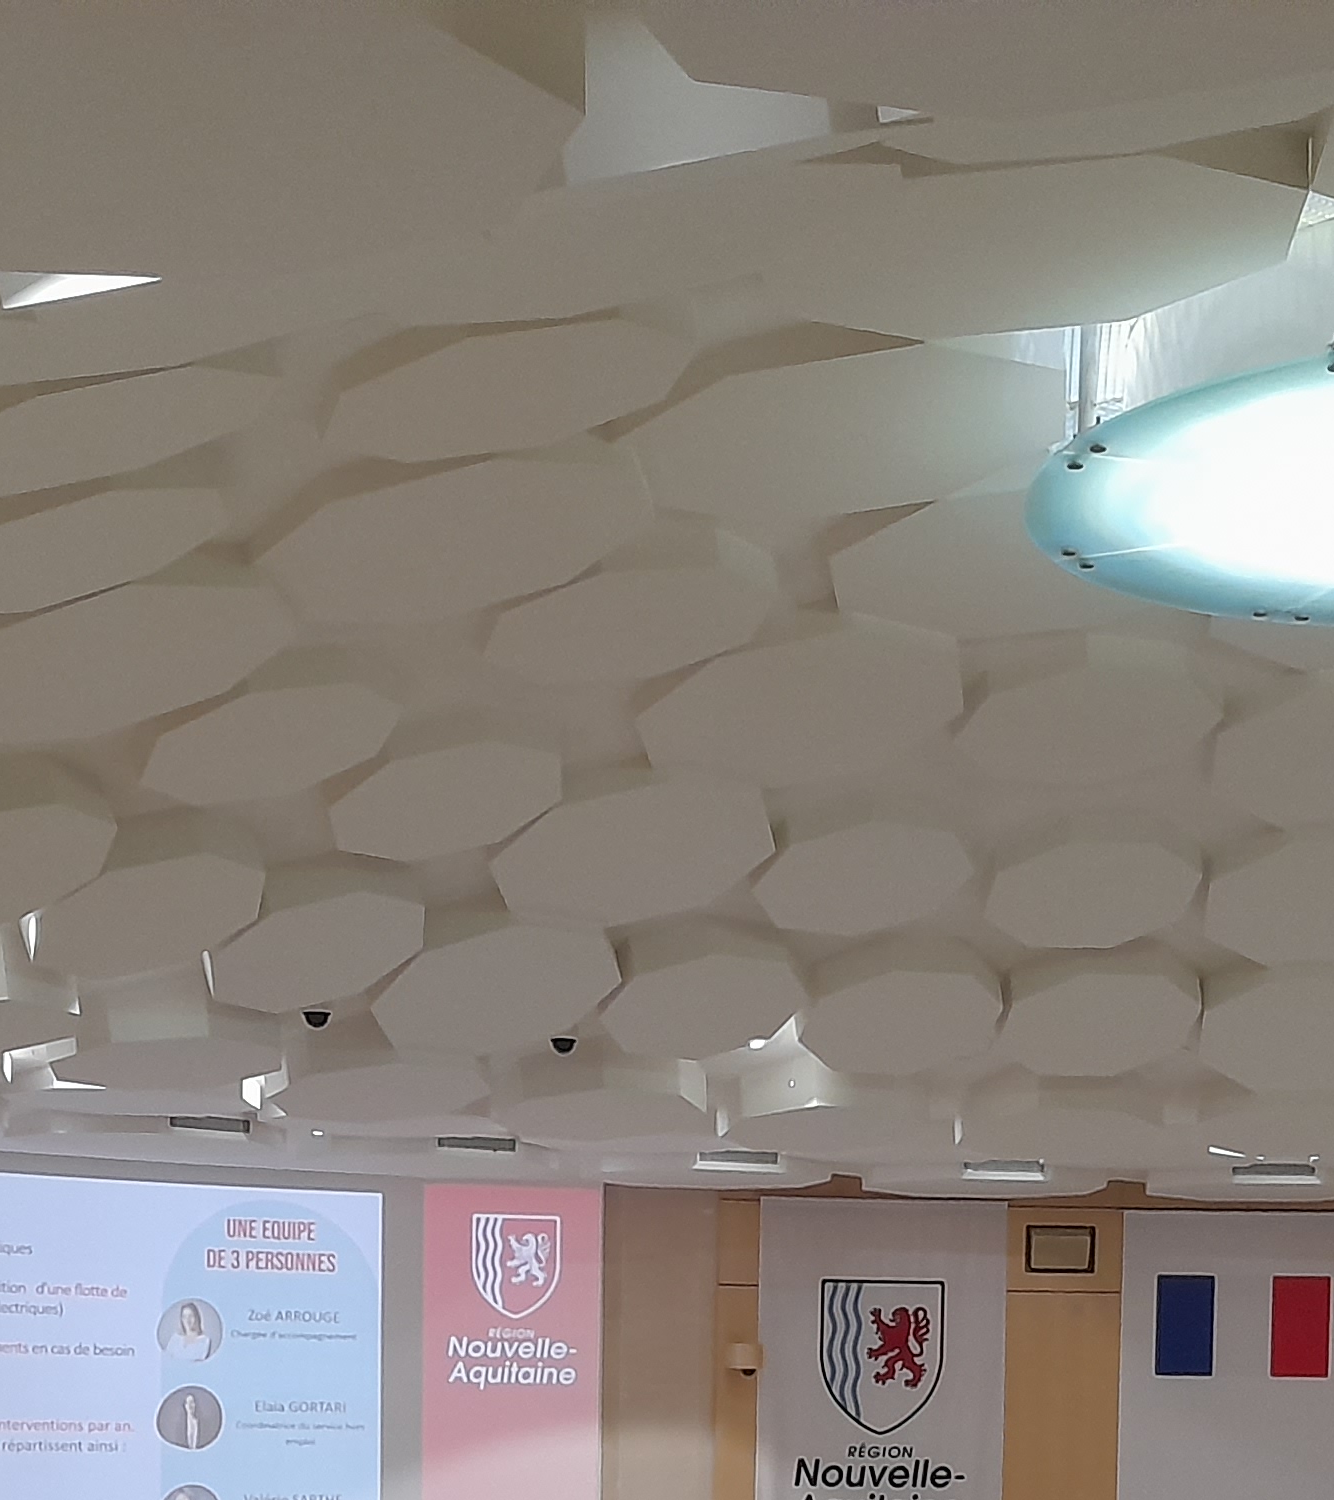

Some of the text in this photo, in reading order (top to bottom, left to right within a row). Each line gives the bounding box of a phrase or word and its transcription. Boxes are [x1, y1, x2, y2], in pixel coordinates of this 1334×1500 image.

[226, 1218, 316, 1242] UNE EQUIPE
[206, 1248, 337, 1273] DE 3 PERSONNES
[35, 1281, 72, 1296] d'une
[73, 1282, 109, 1298] flotte
[110, 1284, 128, 1299] de
[274, 1310, 341, 1324] ARROUGE
[31, 1344, 48, 1355] en
[50, 1344, 72, 1356] cas
[73, 1341, 91, 1356] de
[92, 1342, 136, 1358] besoin
[448, 1335, 578, 1360] Nouvelle-
[448, 1360, 577, 1391] Aquitaine
[87, 1420, 111, 1434] par
[1, 1437, 84, 1455] répartissent
[86, 1438, 119, 1452] ainsi
[847, 1442, 914, 1459] RÉGION
[793, 1457, 966, 1489] Nouvelle-
